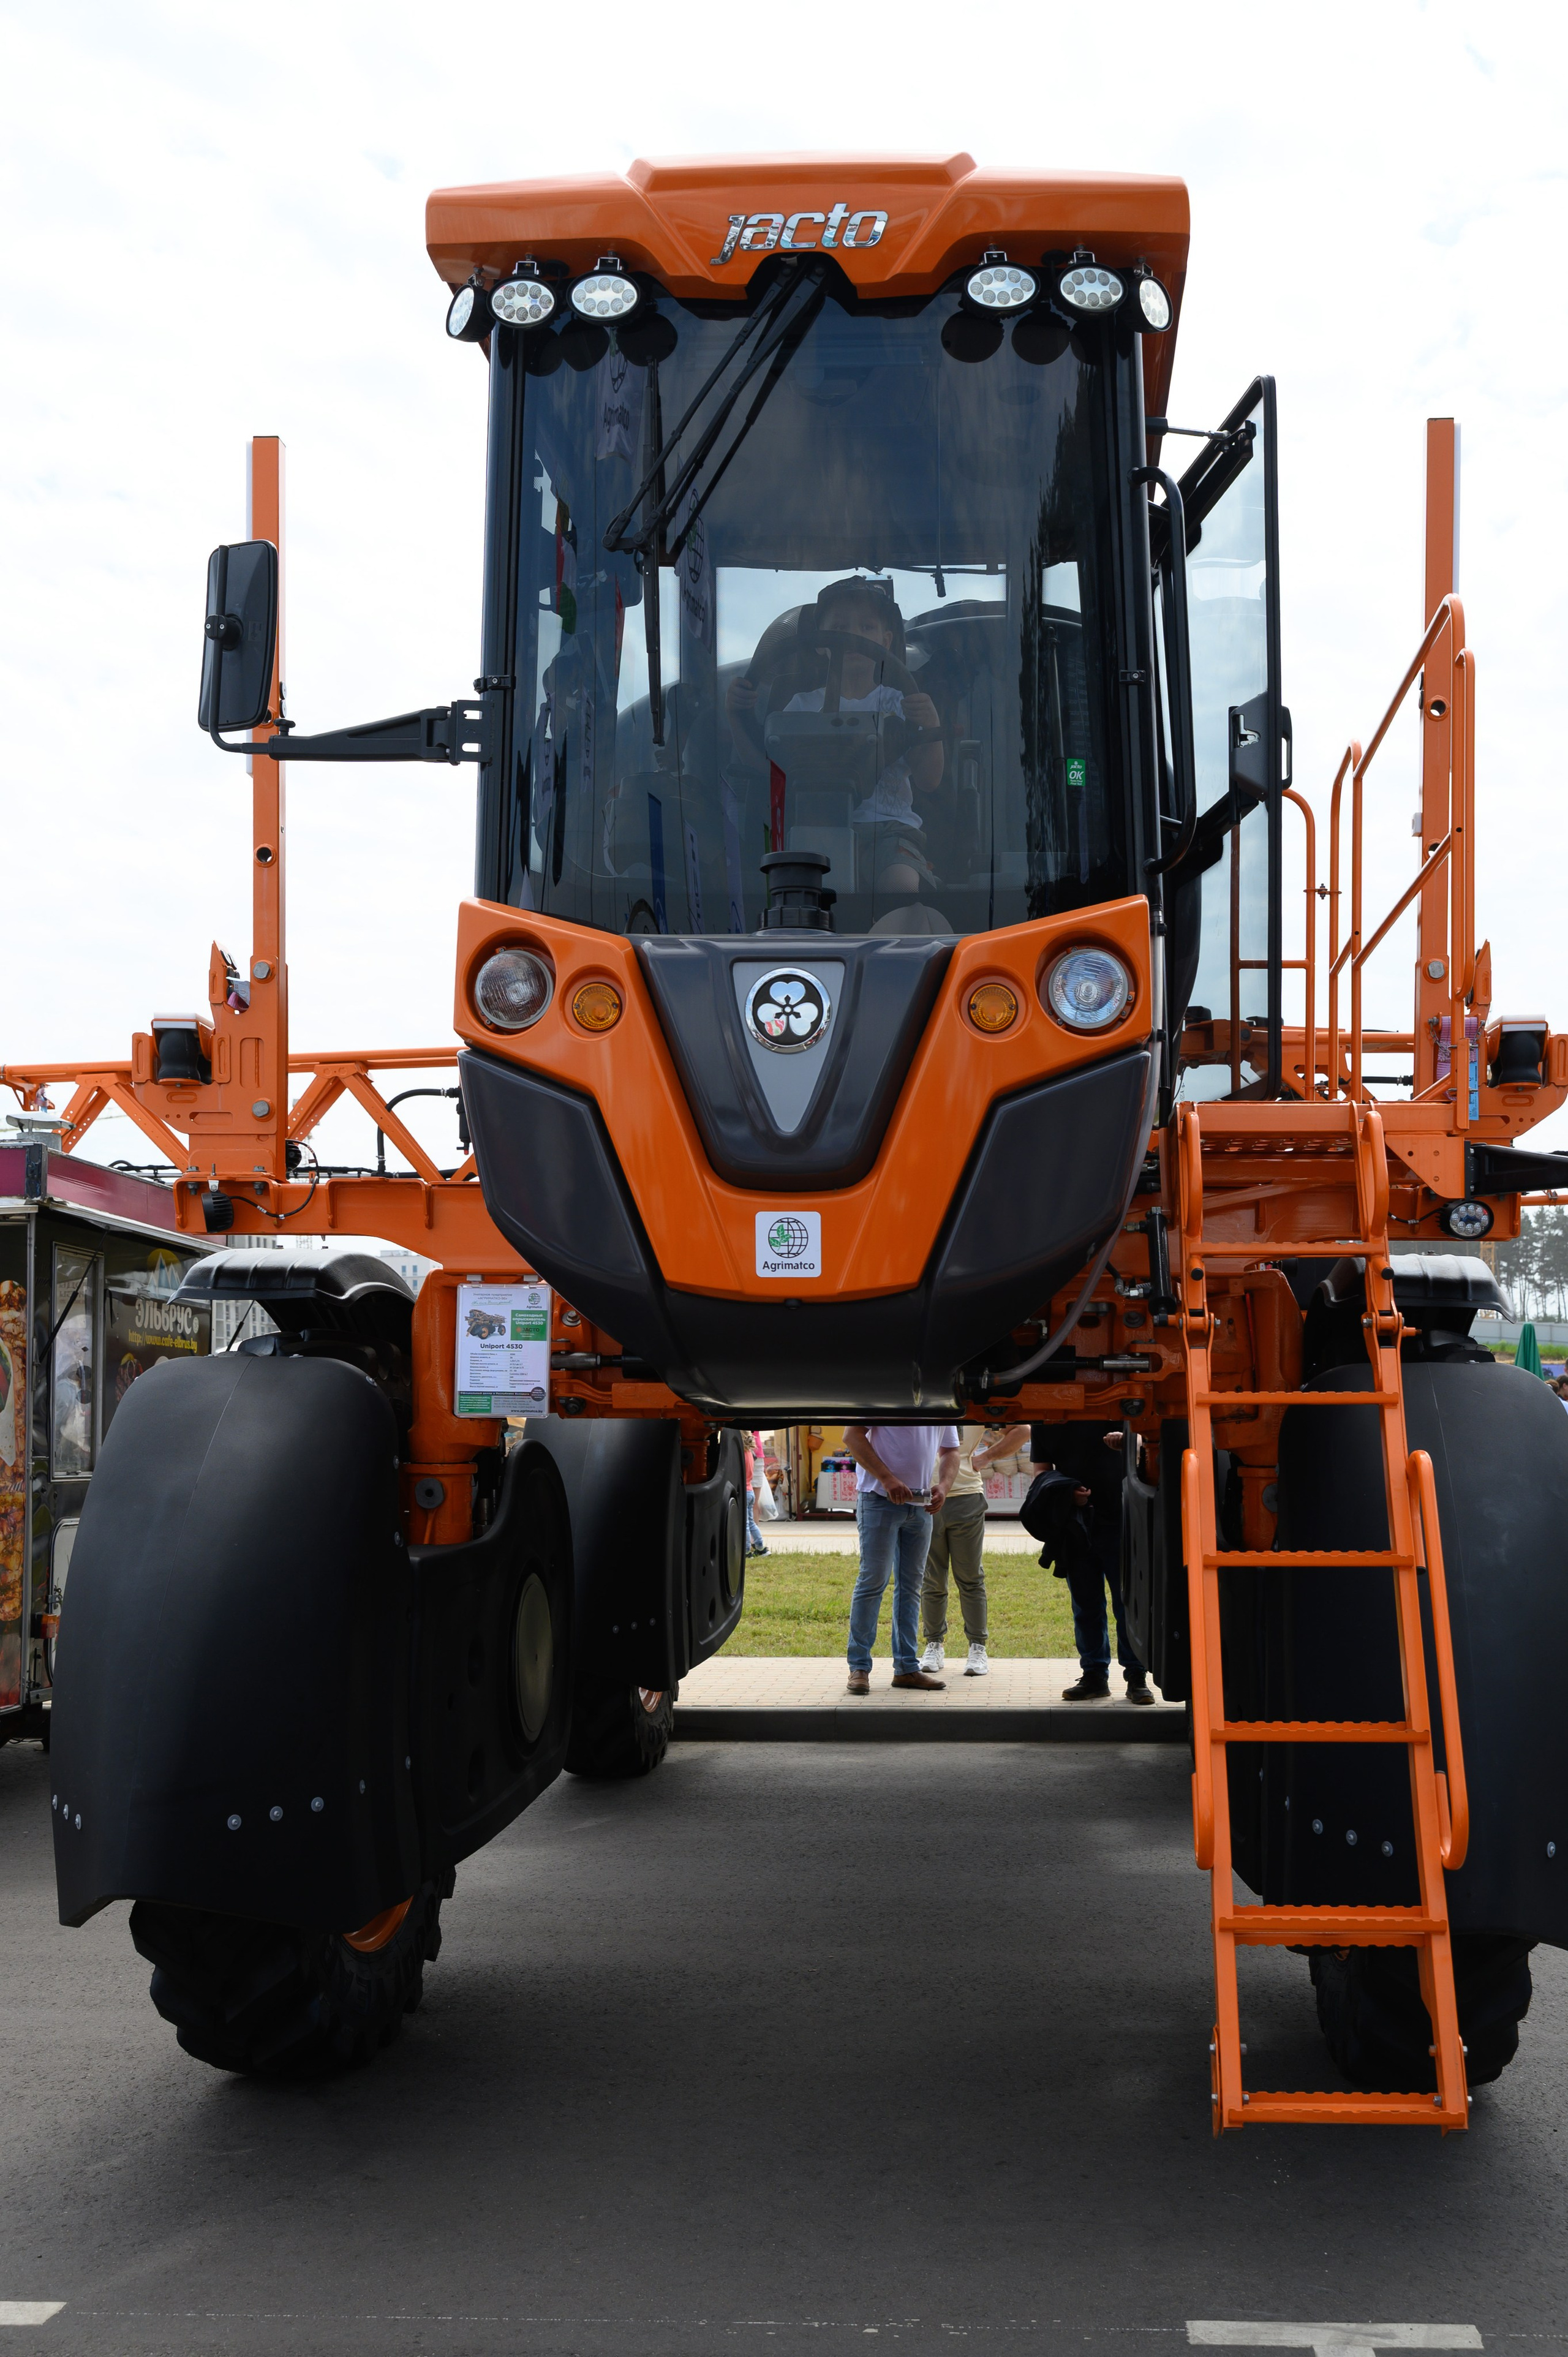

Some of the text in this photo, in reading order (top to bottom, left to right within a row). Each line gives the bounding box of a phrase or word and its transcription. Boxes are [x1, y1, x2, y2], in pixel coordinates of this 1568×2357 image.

[710, 202, 889, 265] jacto
[1069, 771, 1084, 780] OK
[763, 1261, 815, 1272] Agrimatco
[135, 1298, 192, 1335] ЭЛЬБРУС
